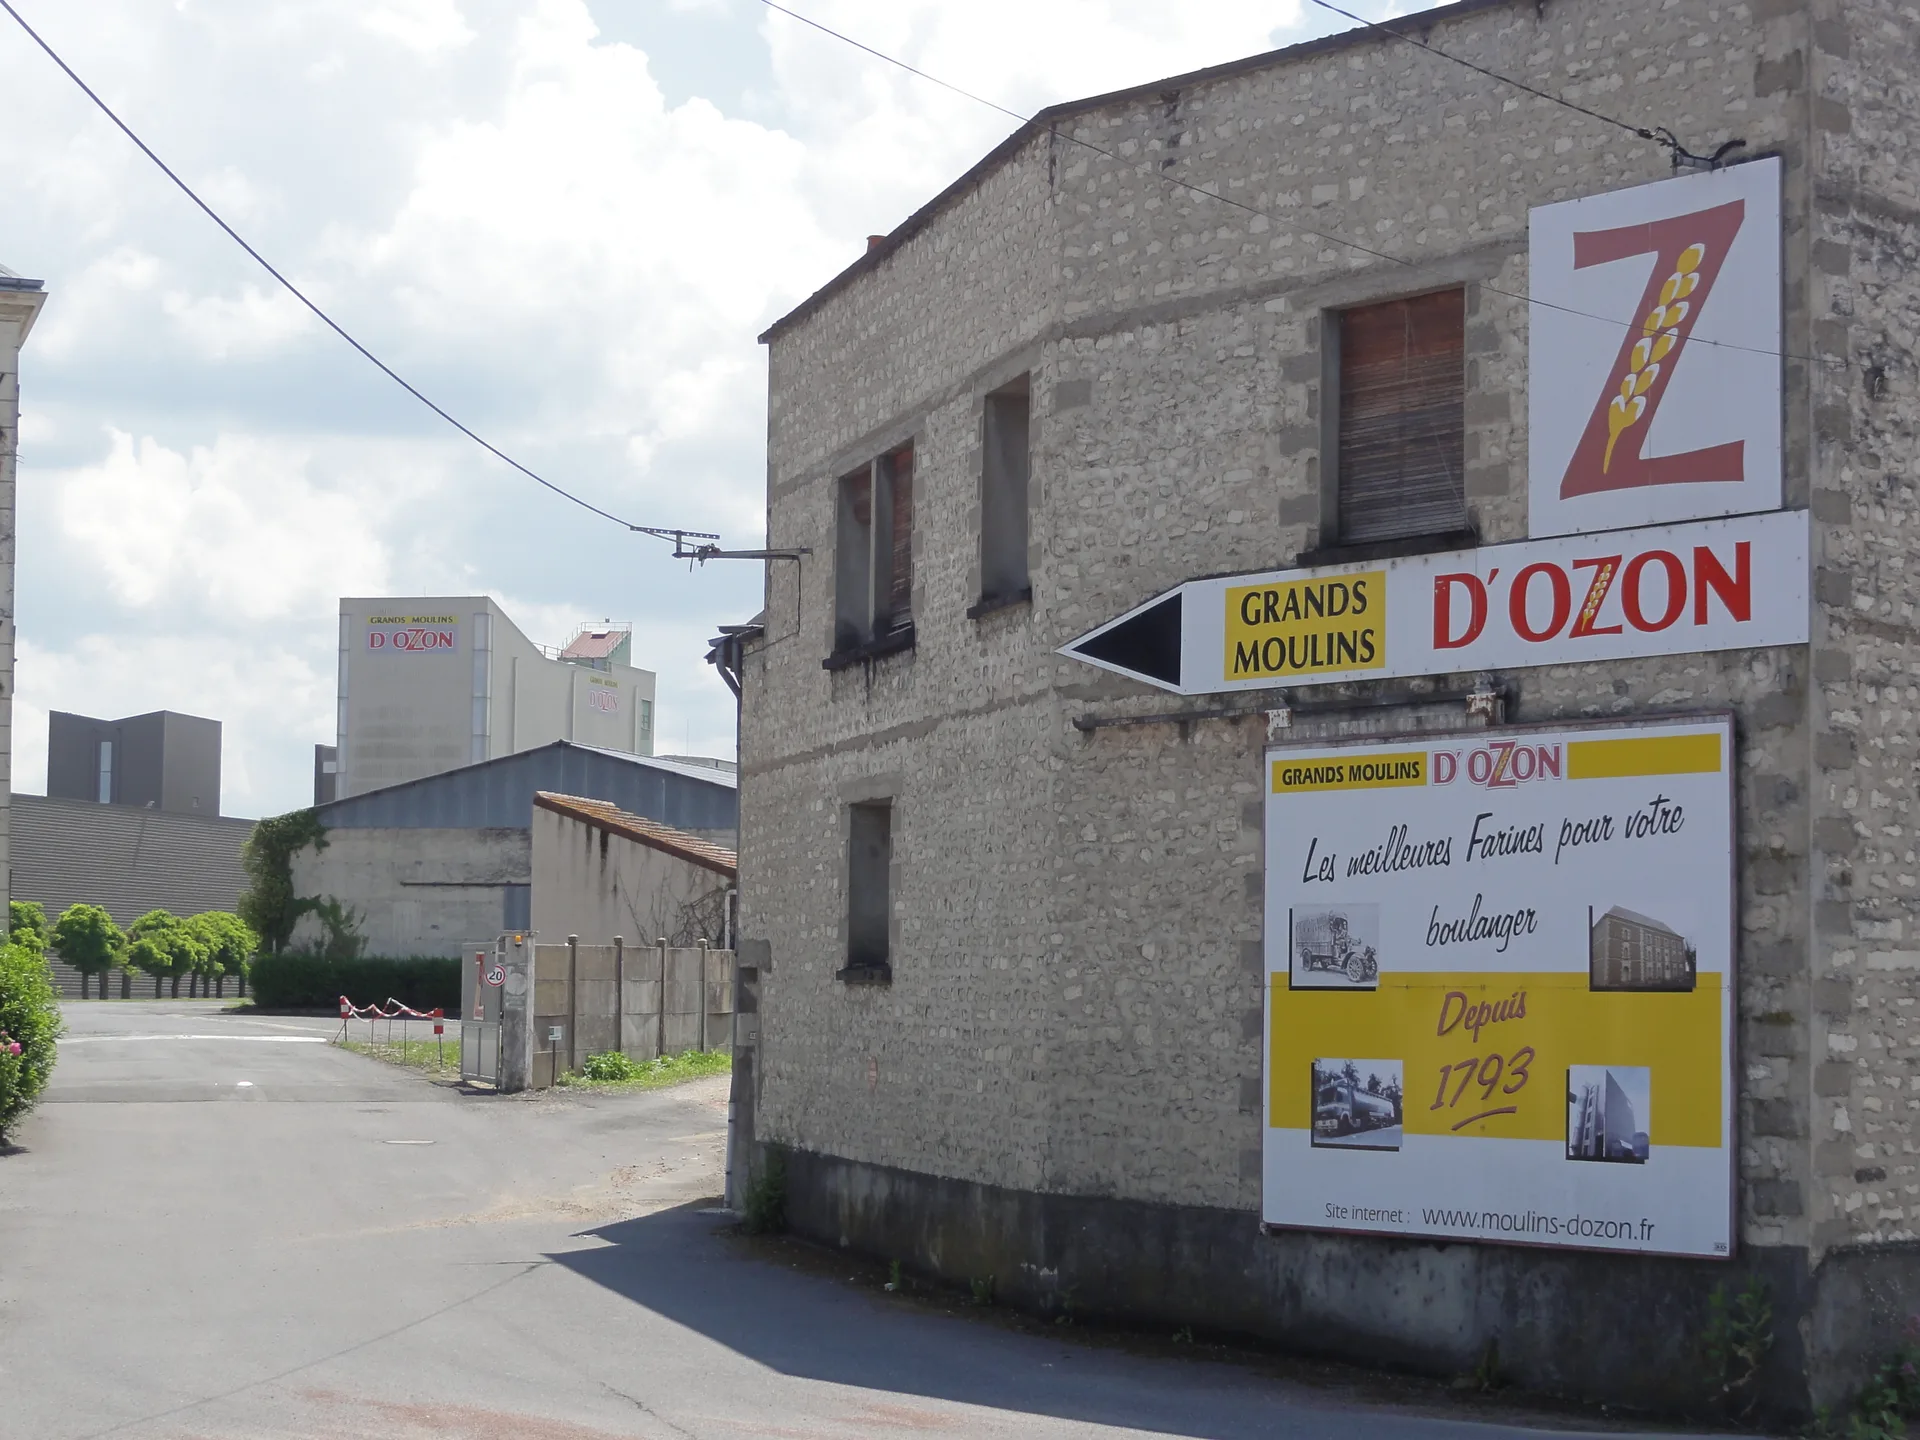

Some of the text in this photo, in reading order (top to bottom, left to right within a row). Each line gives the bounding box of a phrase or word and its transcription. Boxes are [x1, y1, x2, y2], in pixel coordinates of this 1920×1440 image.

[1560, 199, 1745, 500] Z
[1240, 579, 1367, 626] GRANDS
[1433, 541, 1751, 650] D'OZON
[369, 628, 453, 651] D'OZON
[370, 616, 453, 624] GRANDS MOULINS
[1233, 628, 1375, 674] MOULINS
[590, 690, 618, 711] DOZON
[1282, 740, 1562, 790] GRANDS MOULINS D'OZON
[1303, 794, 1685, 883] Les meilleures Farines pour votre
[1426, 893, 1538, 953] boulanger
[489, 971, 503, 981] 20
[1436, 991, 1527, 1043] Depuis
[1430, 1046, 1535, 1111] 1793
[1325, 1203, 1348, 1219] Site
[1351, 1205, 1403, 1223] internet
[1422, 1208, 1655, 1241] www.moulins-dozon.fr
